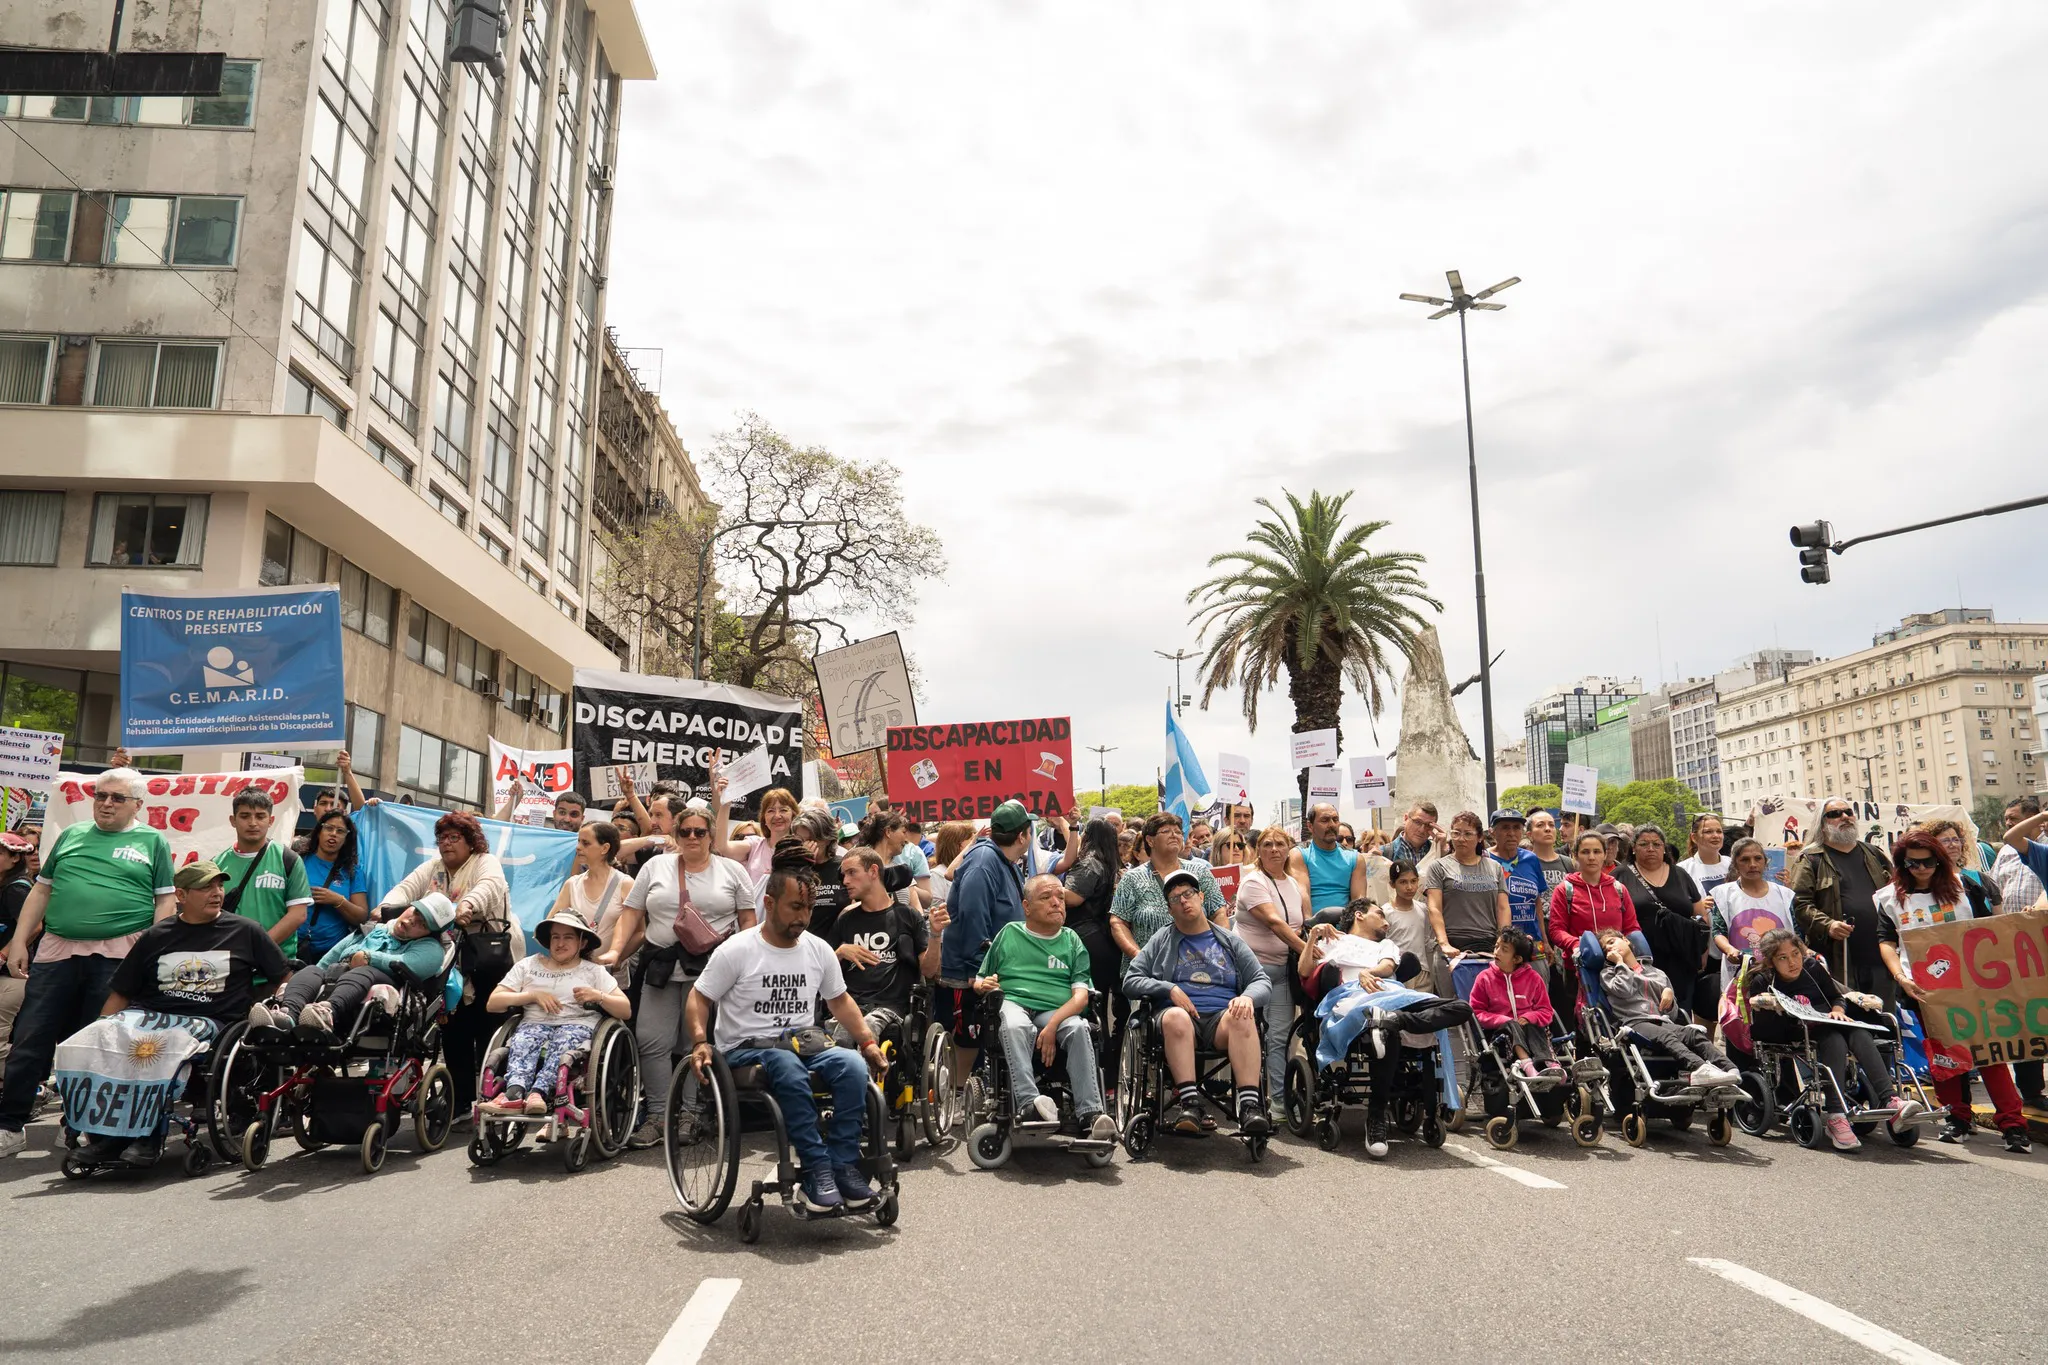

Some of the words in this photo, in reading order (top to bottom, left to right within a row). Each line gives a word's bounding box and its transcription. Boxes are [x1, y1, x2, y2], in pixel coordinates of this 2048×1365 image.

[130, 606, 182, 620] CENTROS
[186, 610, 204, 621] DE
[208, 602, 322, 620] REHABILITACIÓN
[185, 622, 262, 634] PRESENTES
[170, 688, 289, 704] C.E.M.A.R.I.D.
[128, 718, 161, 726] Cámara
[175, 716, 216, 724] Entidades
[216, 713, 247, 722] Médico
[248, 712, 301, 722] Asistenciales
[302, 714, 320, 722] para
[576, 702, 784, 744] DISCAPACIDAD
[10, 730, 42, 739] excusas
[126, 726, 186, 736] Rehabilitación
[187, 724, 257, 734] Interdisciplinaria
[280, 720, 334, 732] Discapacidad
[887, 718, 1070, 750] DISCAPACIDAD
[964, 759, 1002, 781] EN
[854, 932, 890, 951] NO
[762, 974, 807, 988] KARINA
[770, 988, 798, 1001] ALTA
[754, 1000, 809, 1014] COIMERA
[773, 1016, 792, 1028] 3%
[60, 1076, 92, 1123] NO
[90, 1082, 130, 1127] SE
